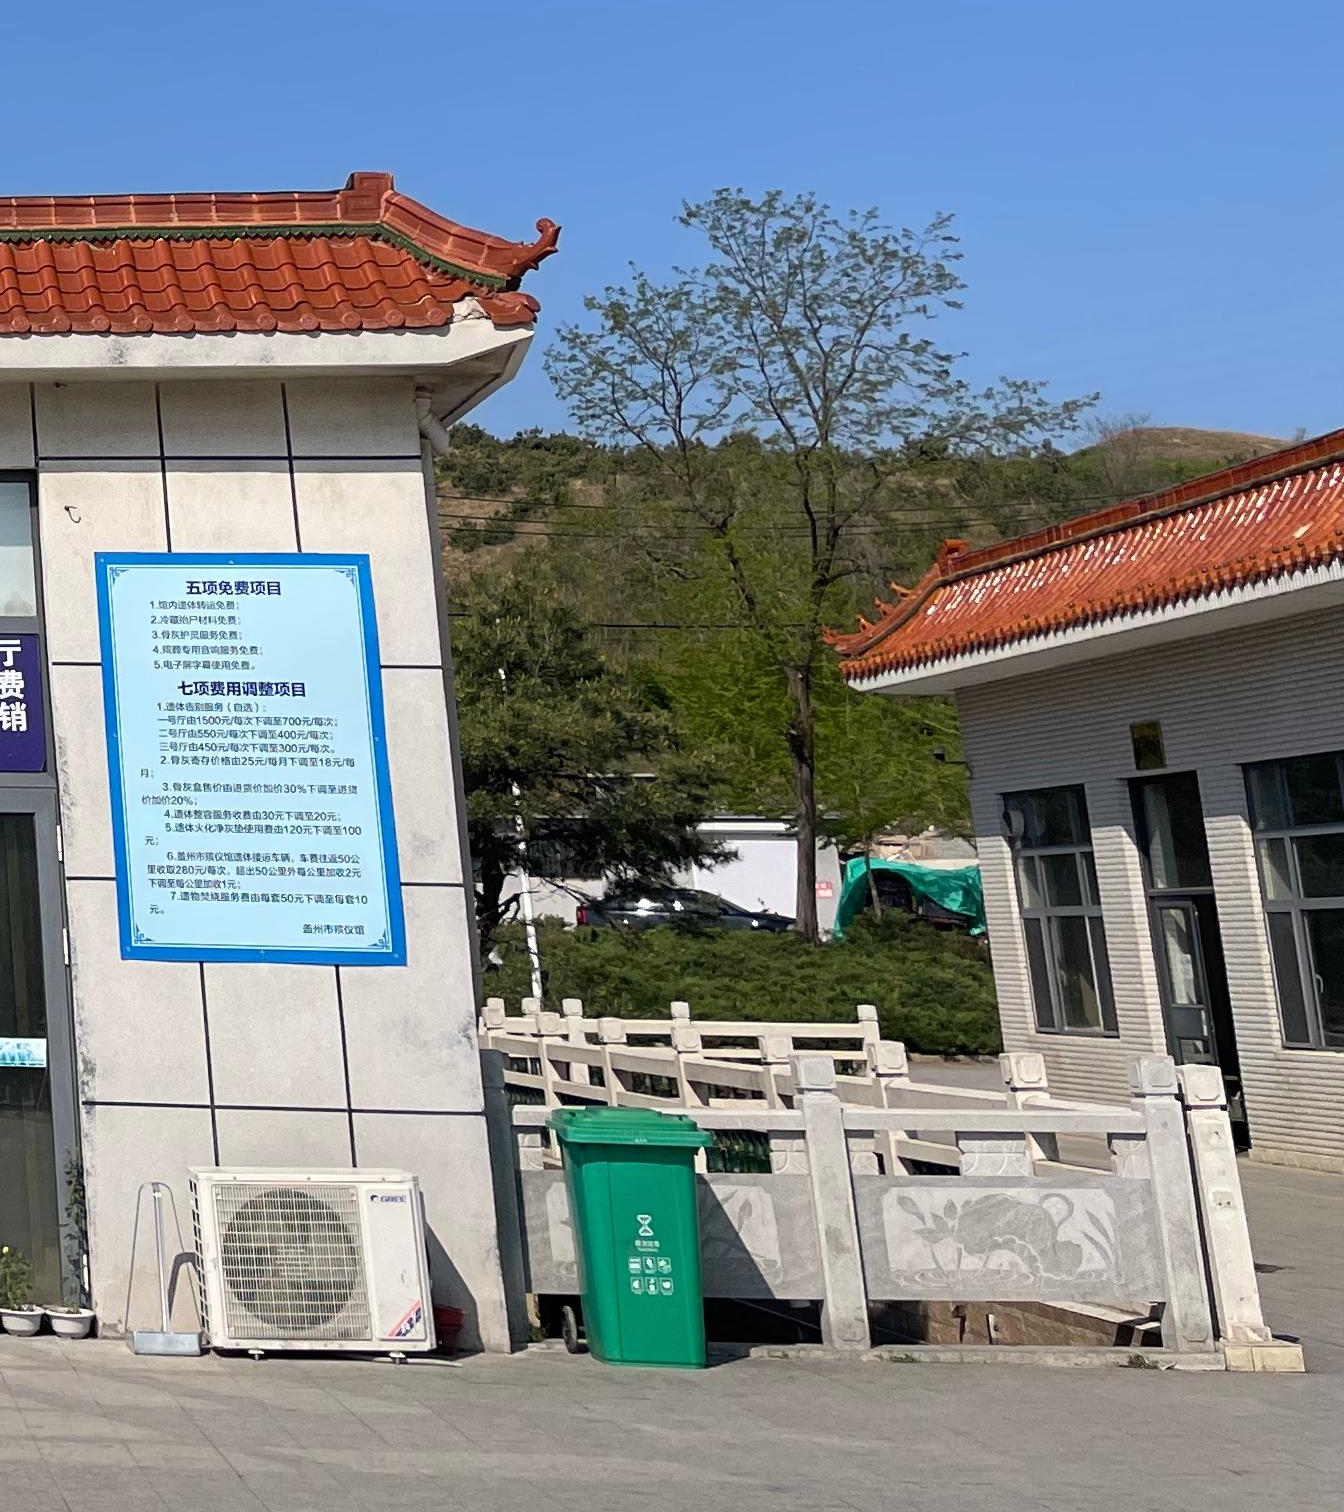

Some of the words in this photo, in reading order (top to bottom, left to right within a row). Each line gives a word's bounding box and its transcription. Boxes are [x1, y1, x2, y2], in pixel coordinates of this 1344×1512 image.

[186, 580, 282, 596] 五项免费项目
[178, 680, 307, 698] 七项费用调整项目
